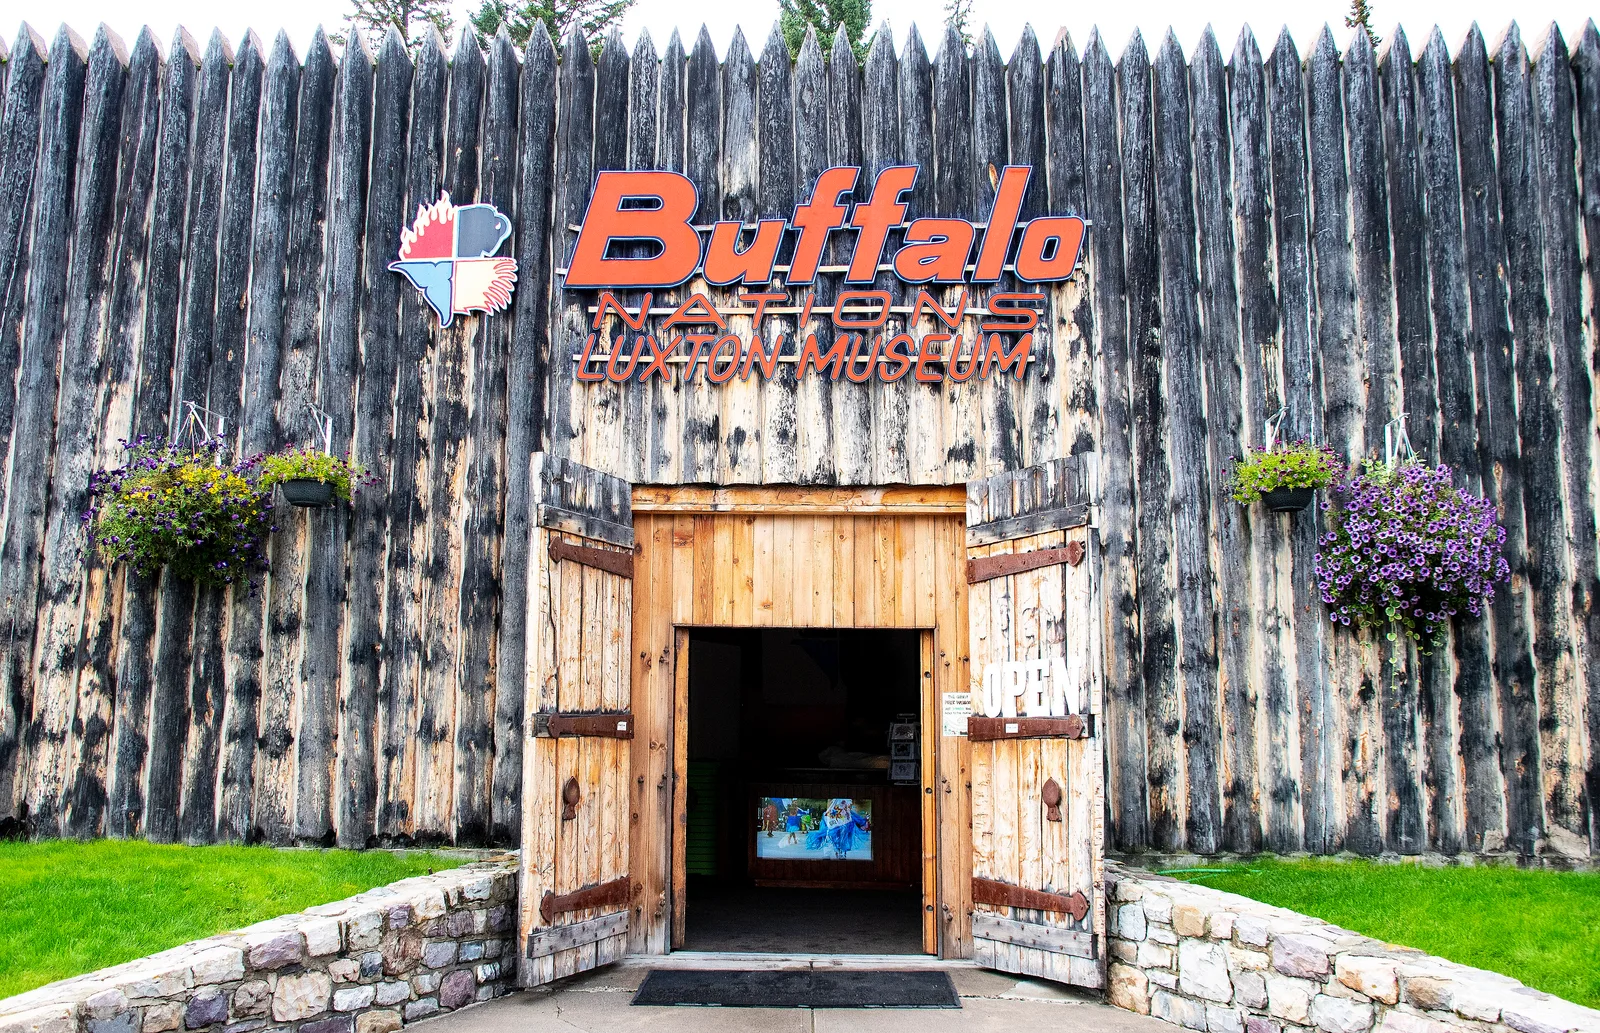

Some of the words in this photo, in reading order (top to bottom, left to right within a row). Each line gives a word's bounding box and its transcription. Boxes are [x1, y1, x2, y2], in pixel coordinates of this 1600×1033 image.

[562, 165, 1087, 288] Buffalo
[592, 290, 1047, 331] NATIONS
[576, 333, 783, 383] LUXTON
[796, 333, 1034, 383] MUSEUM
[982, 656, 1081, 718] OPEN
